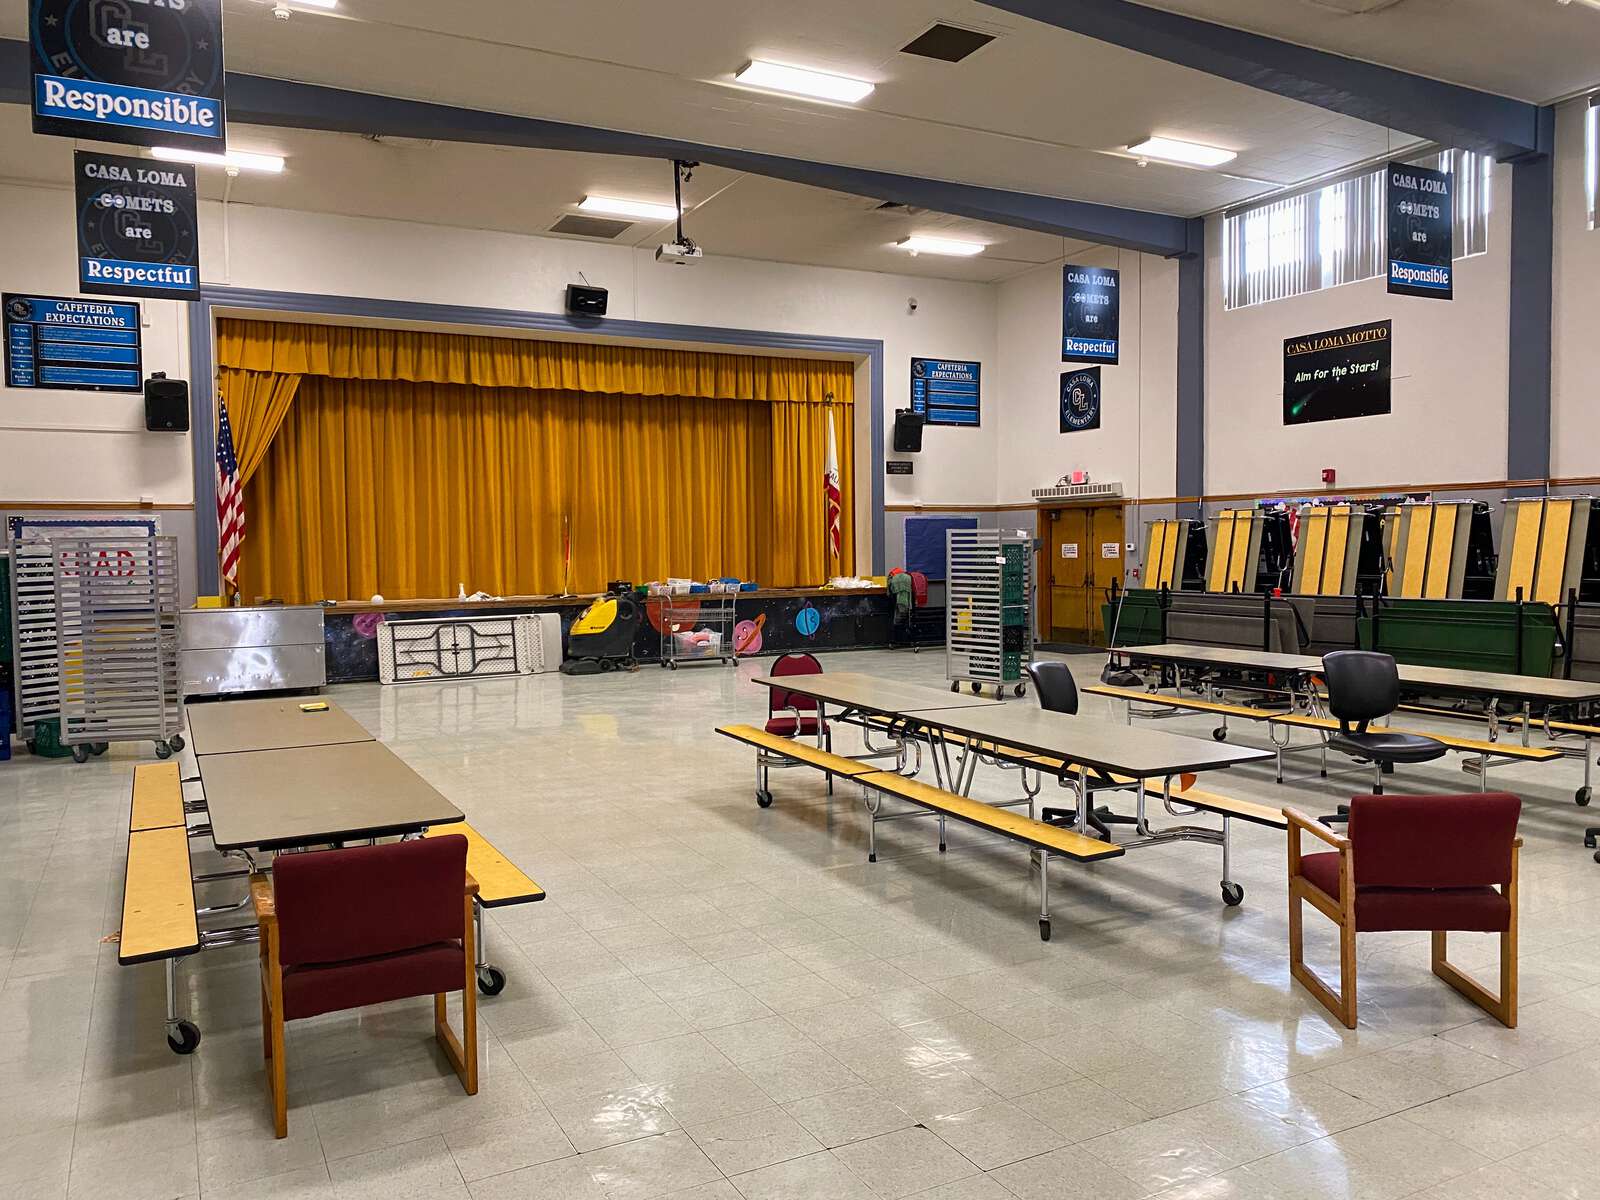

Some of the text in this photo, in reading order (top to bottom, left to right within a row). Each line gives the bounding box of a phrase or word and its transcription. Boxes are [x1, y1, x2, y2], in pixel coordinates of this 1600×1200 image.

[107, 27, 149, 49] are
[44, 80, 214, 128] Responsible
[85, 163, 187, 187] CASA LOMA
[1392, 173, 1448, 195] CASA LOMA
[100, 193, 174, 213] COMETS
[1399, 200, 1440, 219] COMETS
[125, 227, 152, 239] are
[1412, 231, 1427, 243] are
[87, 260, 191, 284] Respectful
[1067, 272, 1116, 287] CASA LOMA
[1391, 262, 1449, 284] Responsible
[1074, 292, 1110, 305] COMETS
[56, 302, 114, 315] CAFETERIA
[45, 312, 125, 327] EXPECTATIONS
[1085, 314, 1098, 323] are
[1066, 338, 1115, 354] Respectful
[1287, 327, 1387, 355] CASA LOMA MOTTO
[931, 370, 973, 380] EXPECTATIONS
[937, 363, 968, 372] CAFETERIA
[1294, 359, 1380, 383] Aim for the Stars!
[1065, 407, 1096, 426] ELEMENTARY
